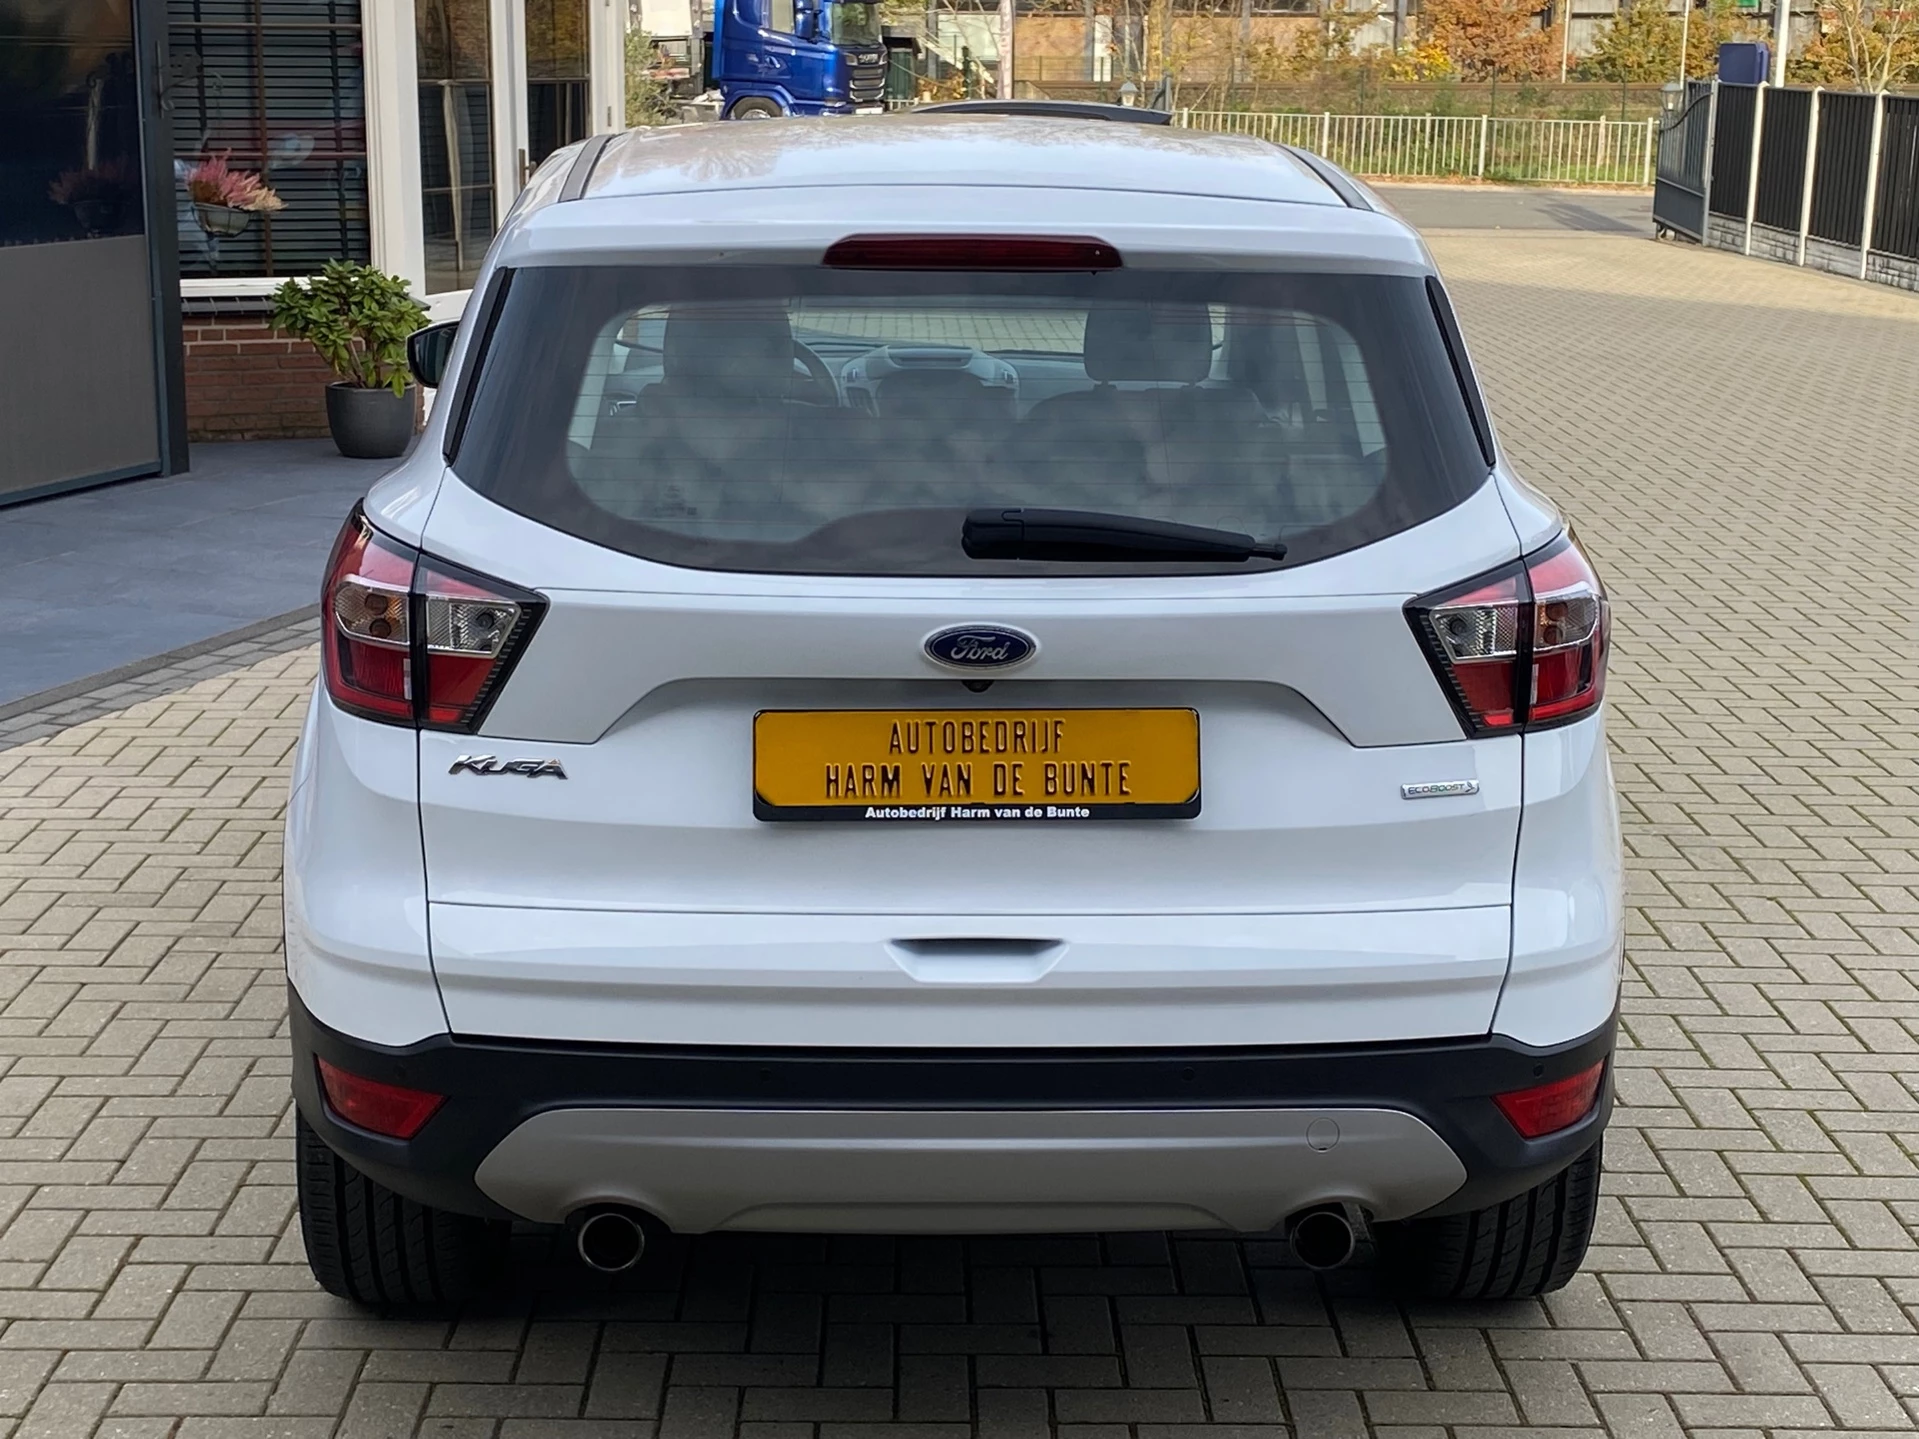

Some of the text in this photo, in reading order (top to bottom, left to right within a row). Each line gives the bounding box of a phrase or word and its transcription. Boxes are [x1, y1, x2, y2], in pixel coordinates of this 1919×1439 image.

[950, 634, 1011, 660] Ford
[888, 718, 1066, 754] AUTOBEDRIJF
[448, 754, 568, 780] KUGA
[825, 761, 1132, 797] HARM VAN DE BUNTE
[1408, 783, 1465, 795] ECOBOOST
[865, 806, 1090, 821] Autobedrijf Harm van de Bunte
